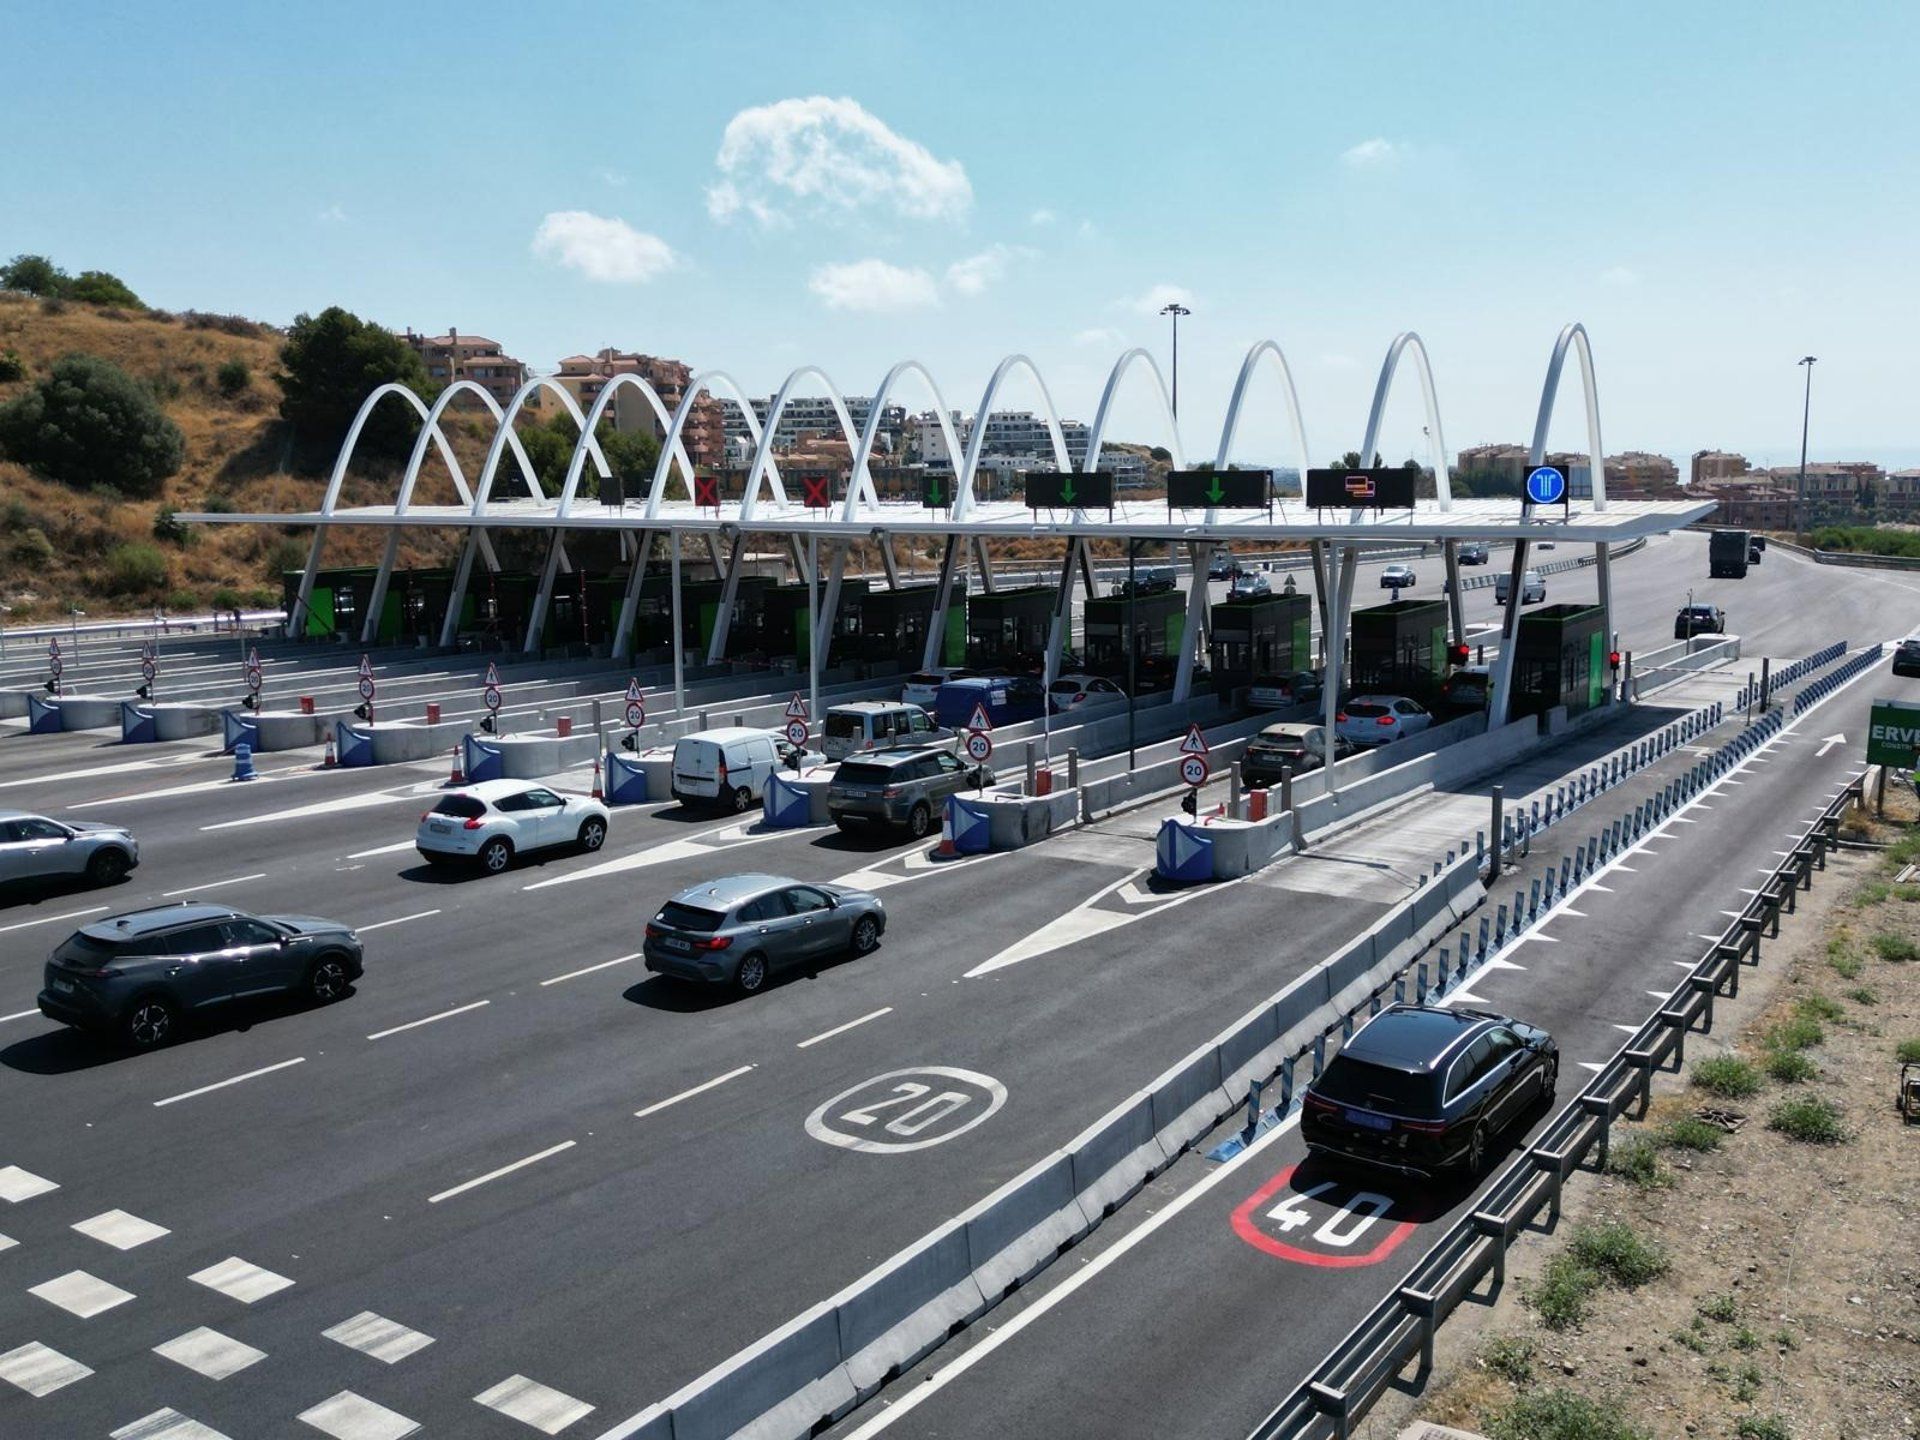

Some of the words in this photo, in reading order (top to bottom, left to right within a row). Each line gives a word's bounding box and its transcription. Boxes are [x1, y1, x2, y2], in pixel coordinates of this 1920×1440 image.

[250, 674, 260, 684] 20
[361, 683, 372, 693] 20
[488, 693, 498, 704] 20
[629, 709, 641, 720] 20
[791, 727, 804, 738] 20
[972, 741, 986, 752] 20
[1186, 765, 1202, 776] 20
[840, 1082, 972, 1136] 20
[1266, 1182, 1395, 1247] 40
